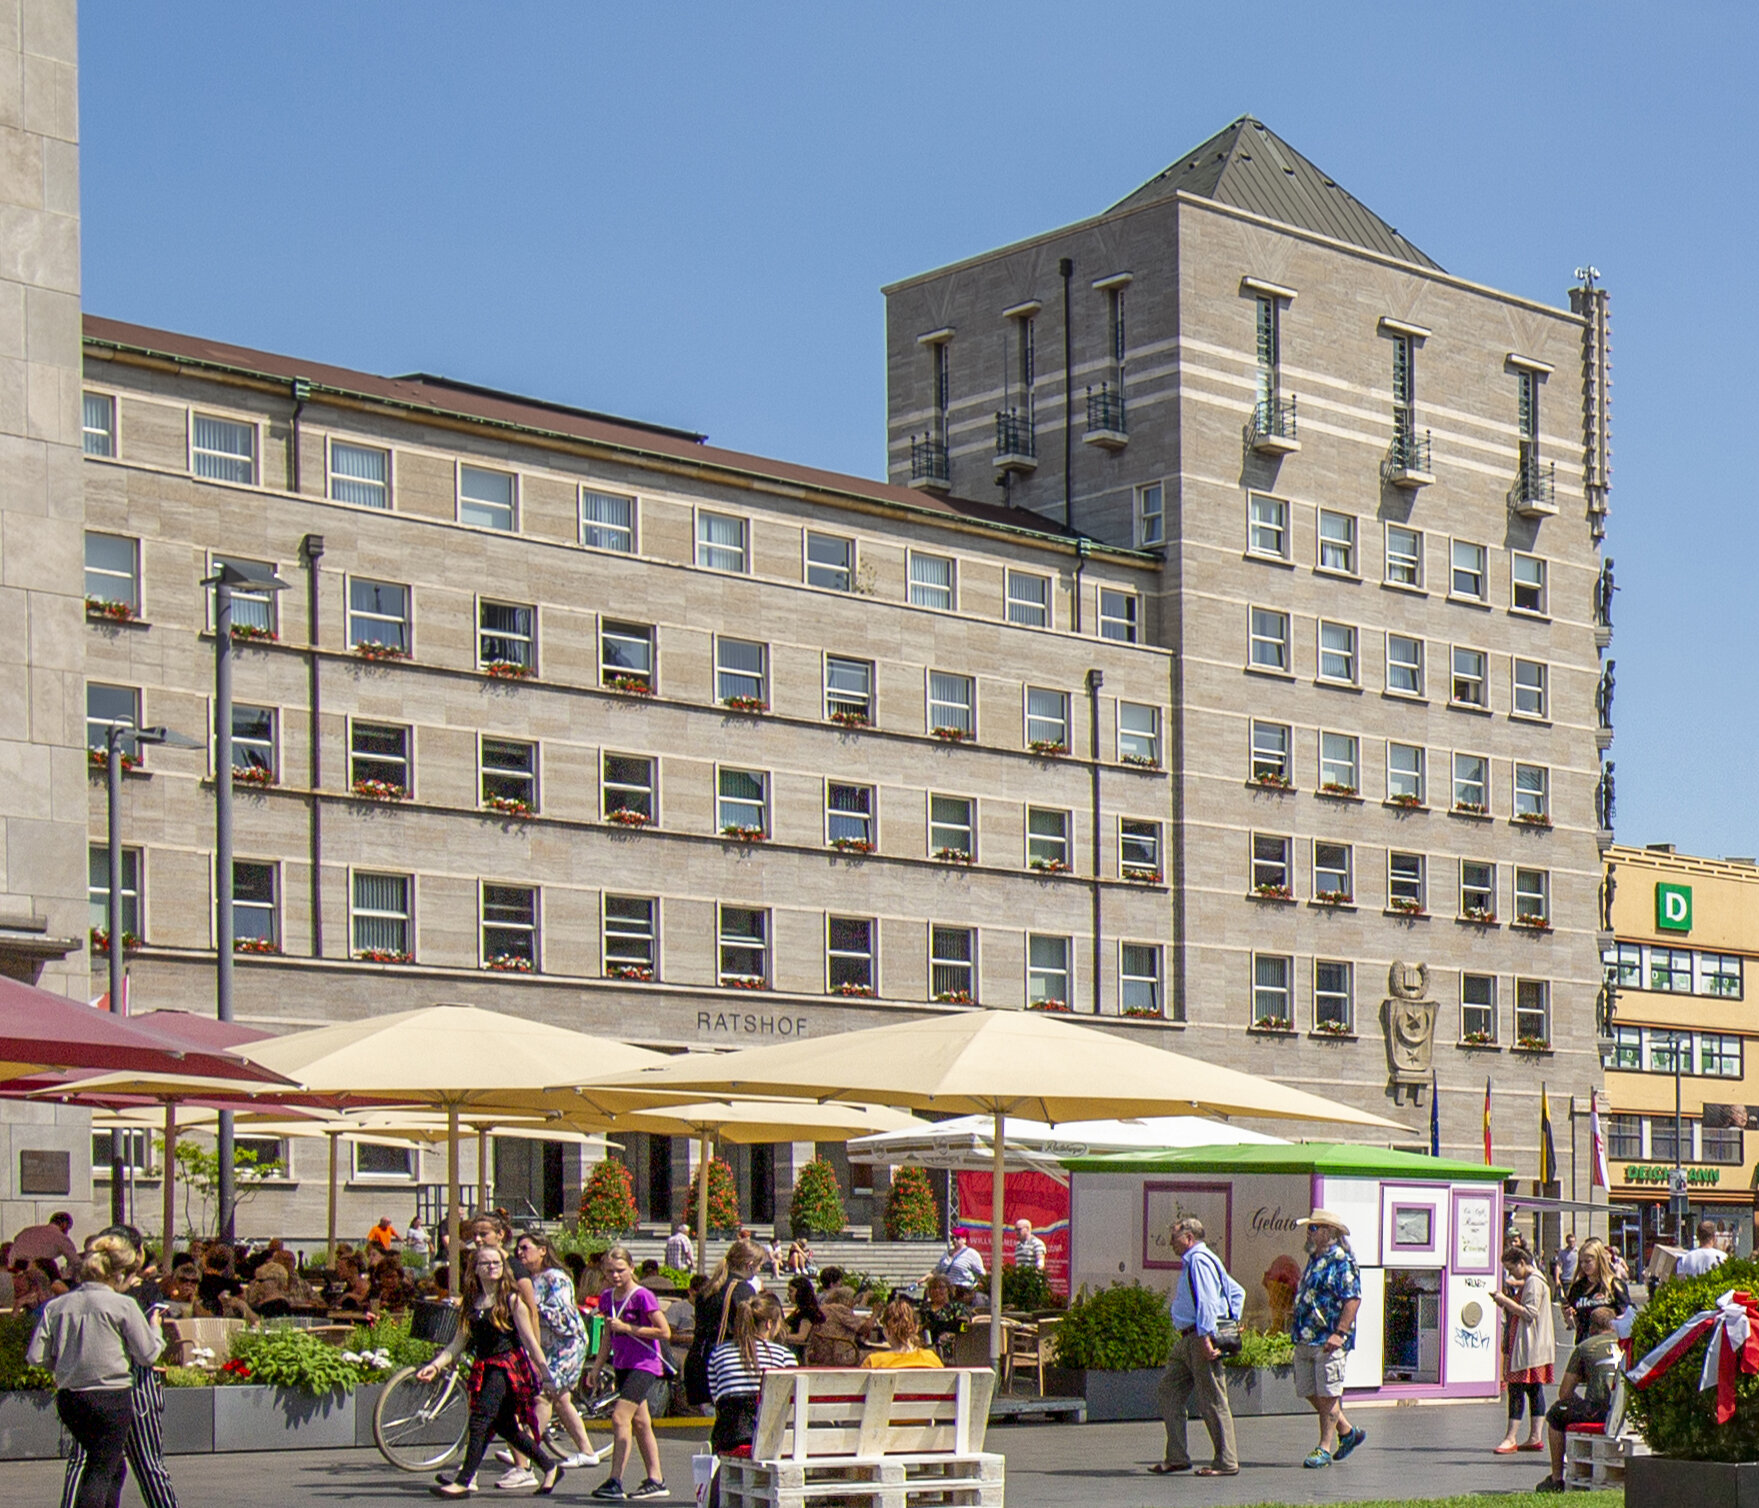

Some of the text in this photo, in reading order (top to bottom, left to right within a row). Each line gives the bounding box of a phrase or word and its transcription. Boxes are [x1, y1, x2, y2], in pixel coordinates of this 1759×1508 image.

[1665, 892, 1688, 922] D
[697, 1012, 807, 1035] RATSHOF
[1250, 1206, 1299, 1236] Gelato
